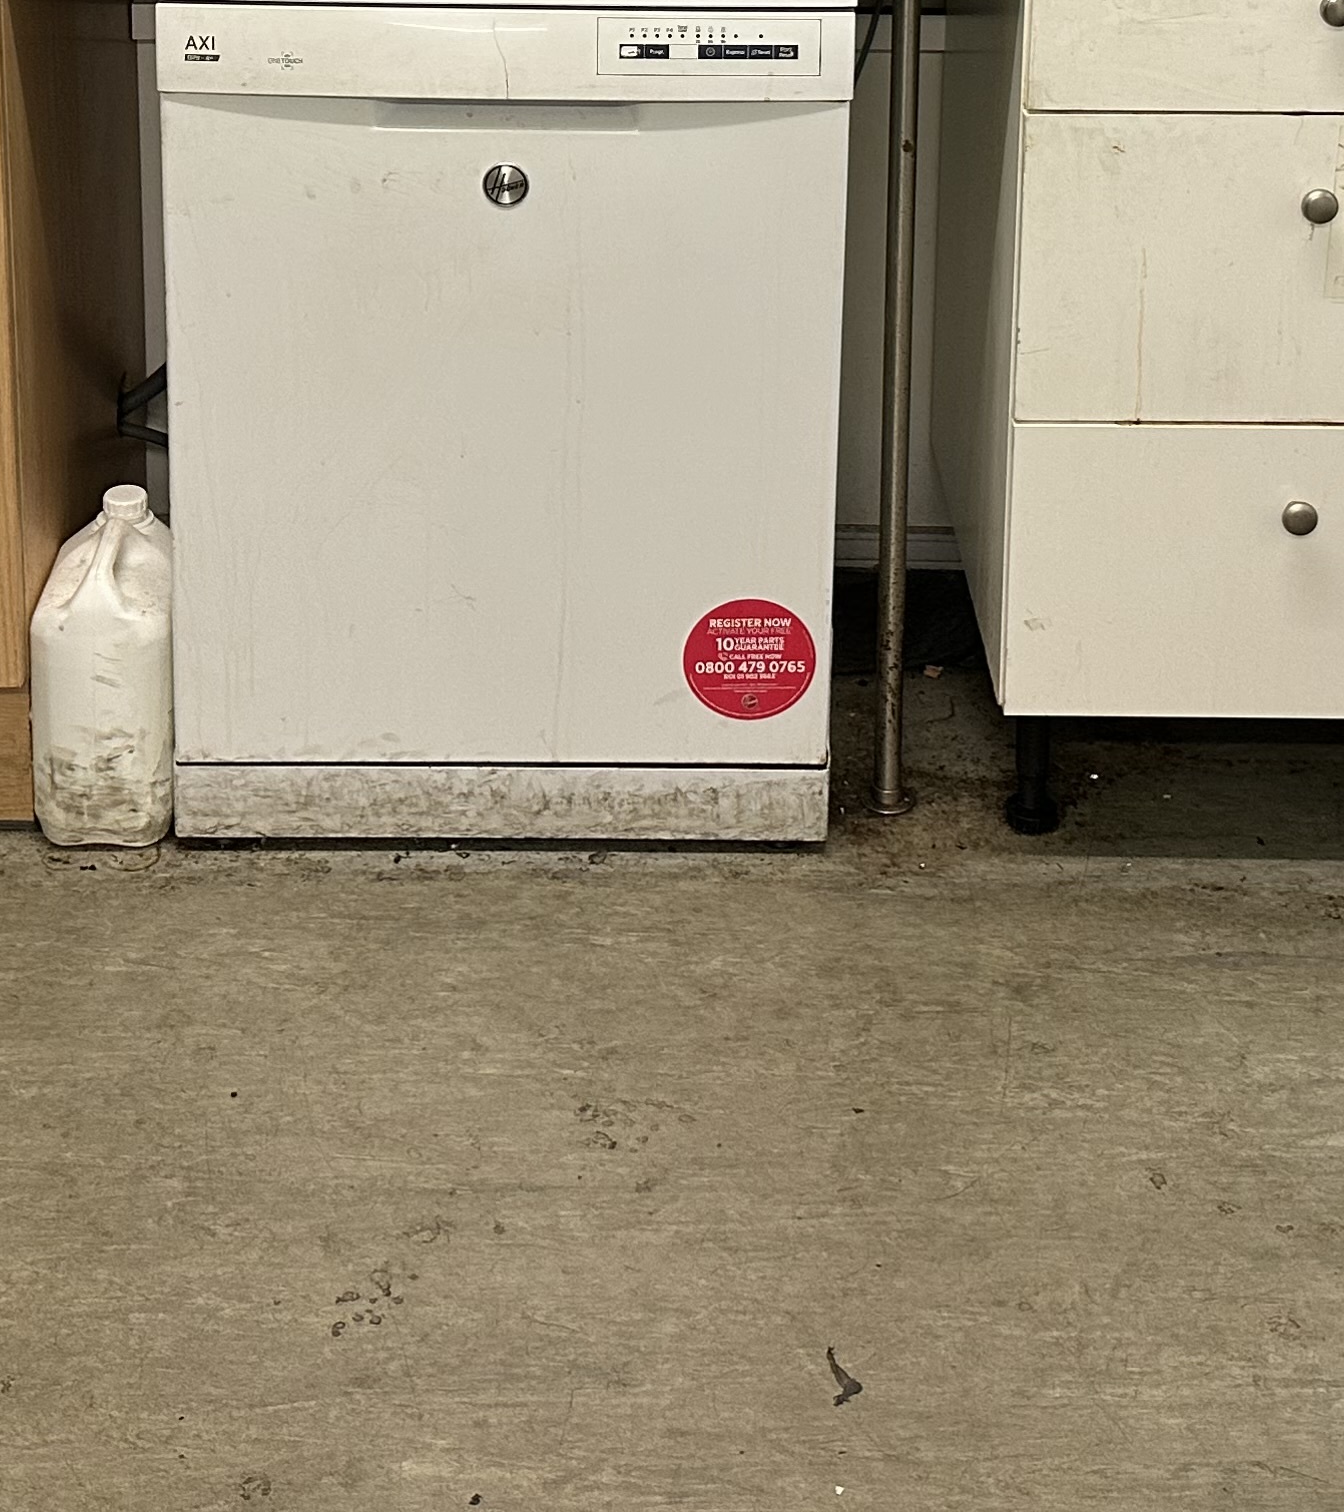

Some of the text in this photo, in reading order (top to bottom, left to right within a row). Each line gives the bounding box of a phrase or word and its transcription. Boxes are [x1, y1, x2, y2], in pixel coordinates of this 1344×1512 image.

[184, 35, 215, 50] AXI
[709, 617, 792, 628] REGISTER NOW
[715, 637, 734, 651] 10
[758, 636, 784, 644] PARTS
[734, 643, 784, 651] GUARANTEE
[695, 661, 806, 674] 0800 479 0765
